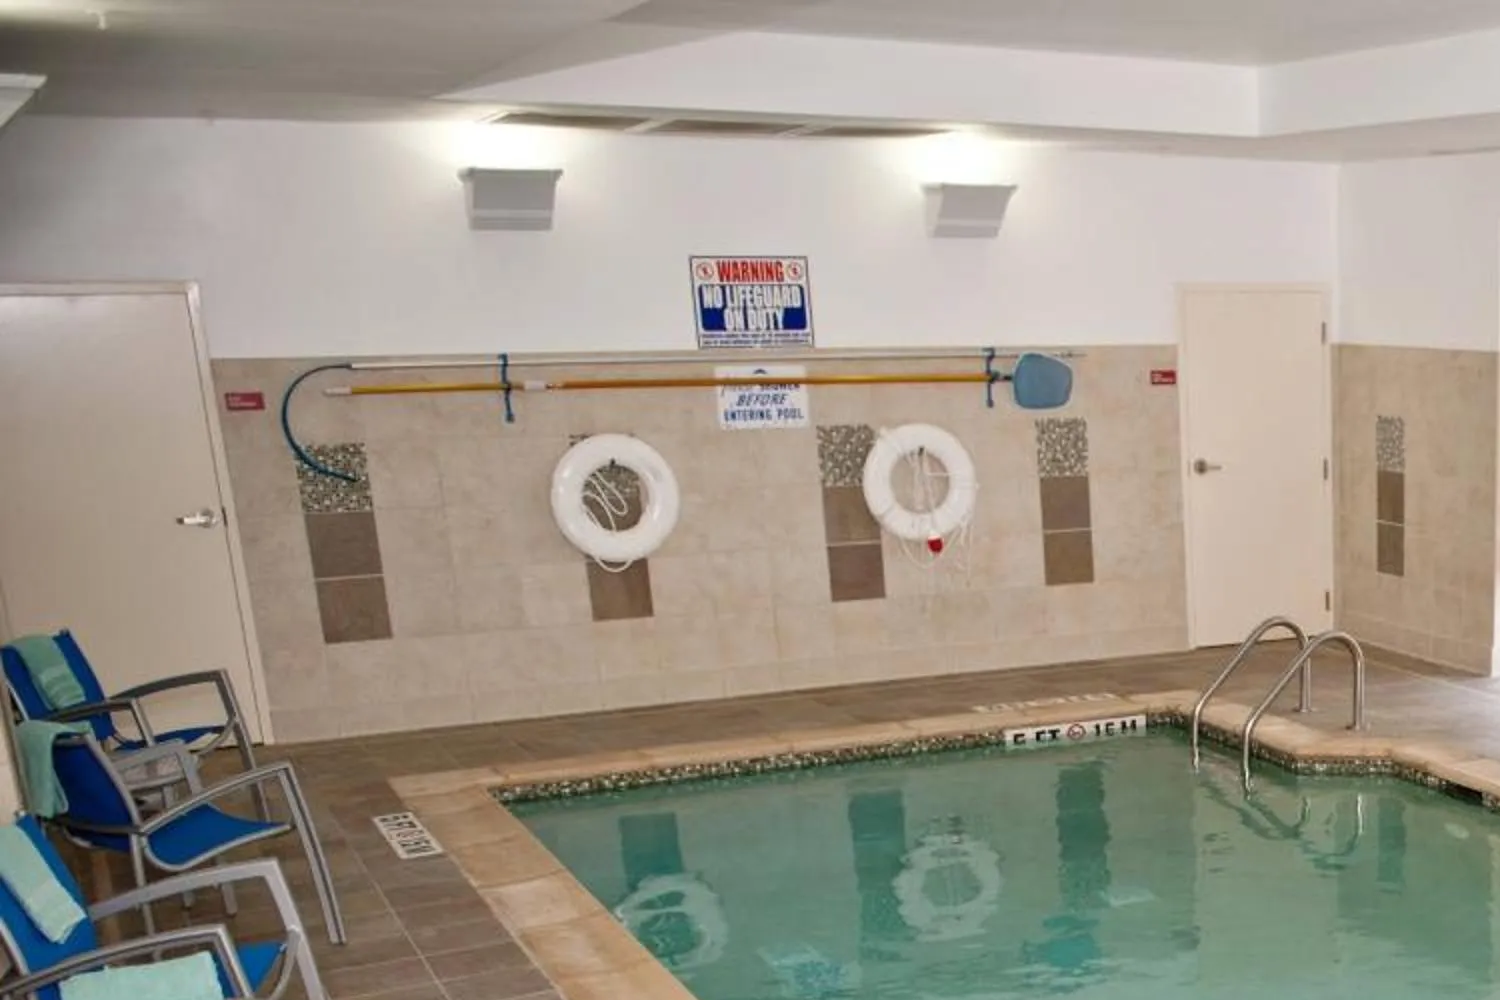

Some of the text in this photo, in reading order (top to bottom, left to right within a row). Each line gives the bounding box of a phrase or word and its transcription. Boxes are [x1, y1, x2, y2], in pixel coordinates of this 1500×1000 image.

[716, 260, 784, 282] WARNING
[702, 284, 802, 308] NO LIFEGUARD
[723, 307, 784, 331] ON DUTY
[736, 393, 788, 406] BEFORE
[724, 408, 804, 421] ENTERING POOL
